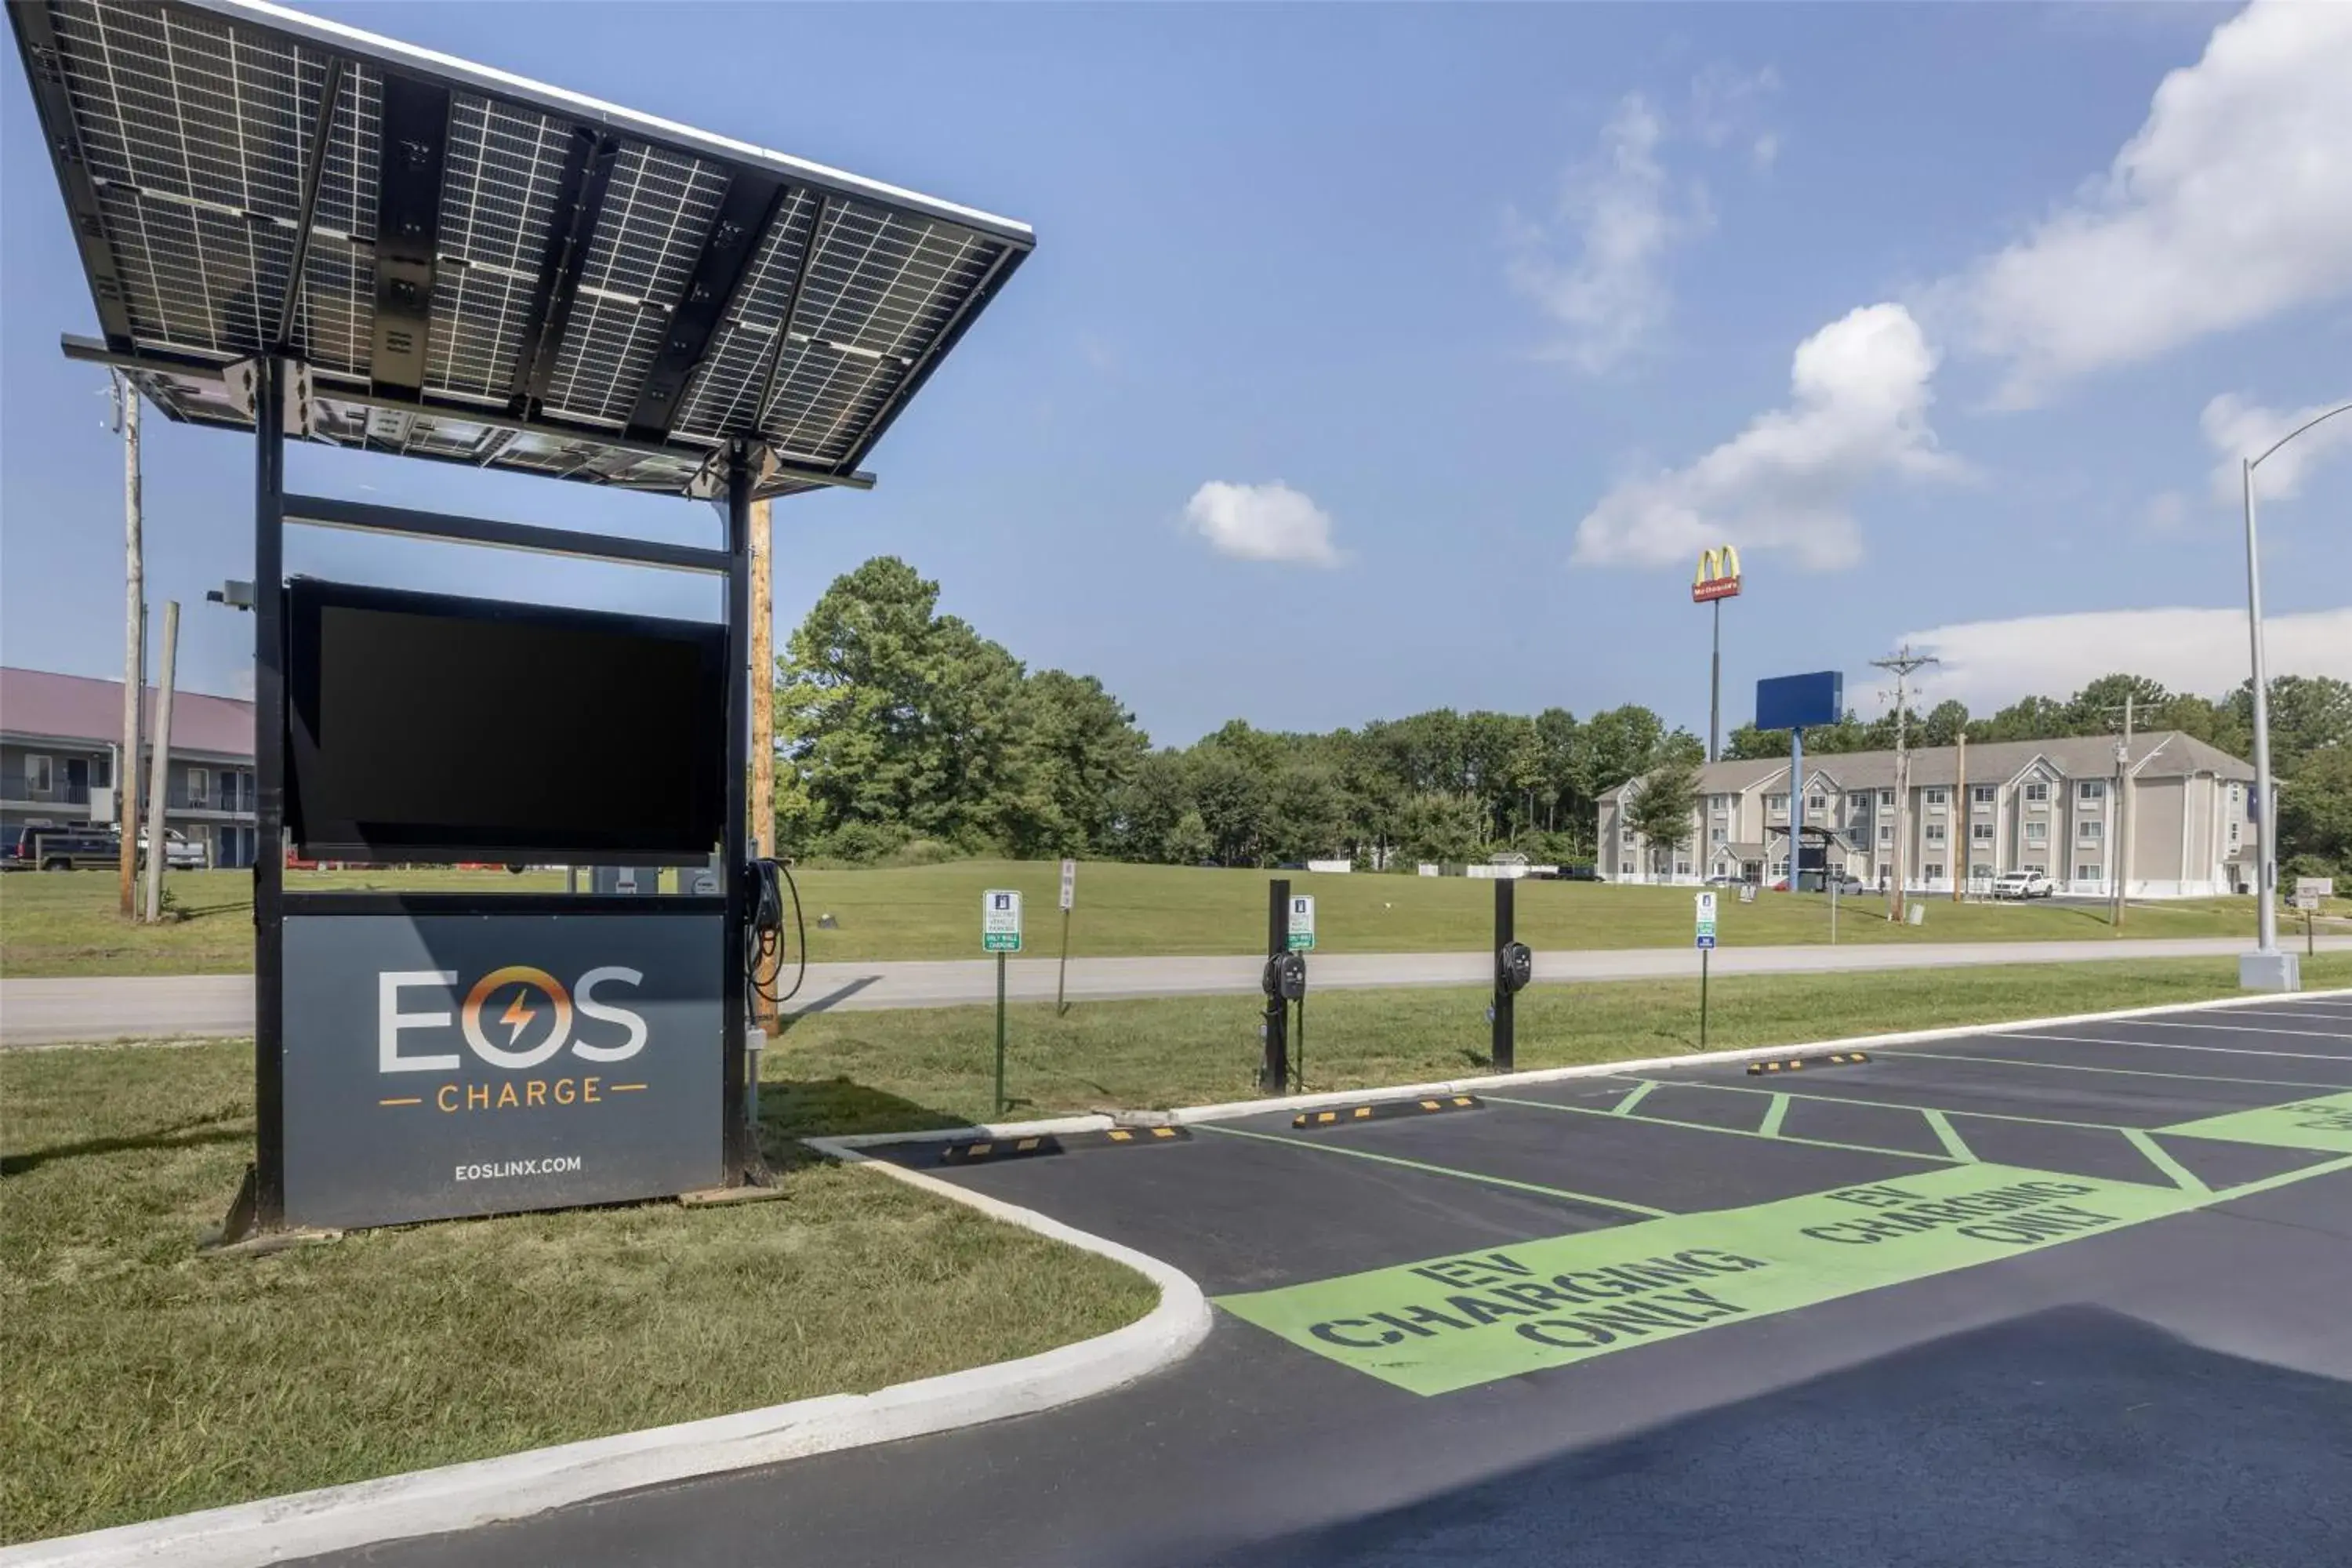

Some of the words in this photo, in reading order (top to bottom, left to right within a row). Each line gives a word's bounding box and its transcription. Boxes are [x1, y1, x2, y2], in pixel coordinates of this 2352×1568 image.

[379, 965, 648, 1073] EOS
[437, 1077, 601, 1112] CHARGE
[455, 1156, 582, 1180] EOSLINX.COM
[1800, 1181, 2100, 1244] CHARGING
[1824, 1185, 1926, 1208] EV
[1956, 1205, 2122, 1244] ONLY
[1409, 1253, 1536, 1289] EV
[1308, 1248, 1769, 1348] CHARGING
[1515, 1287, 1749, 1348] ONLY
